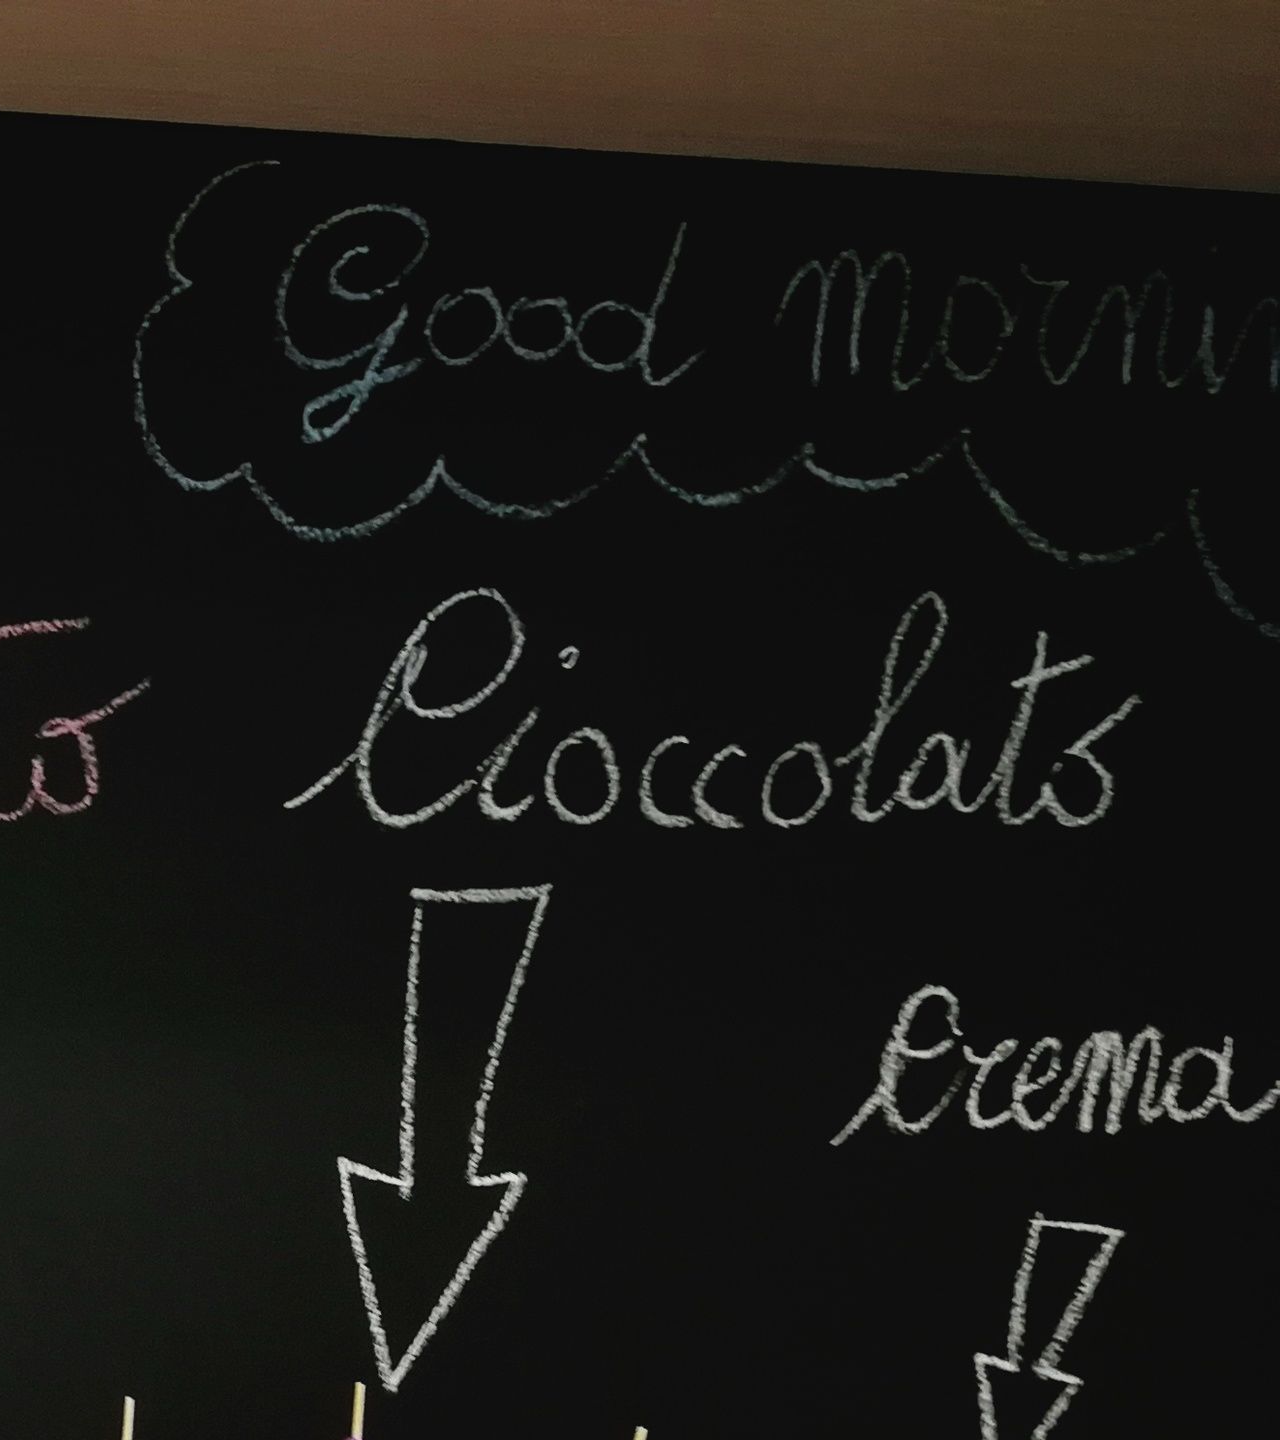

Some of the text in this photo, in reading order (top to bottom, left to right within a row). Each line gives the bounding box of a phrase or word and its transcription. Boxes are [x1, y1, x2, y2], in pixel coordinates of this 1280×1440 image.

[275, 202, 706, 444] Good
[281, 586, 1143, 830] Cioccolato
[829, 983, 1280, 1147] Crema
